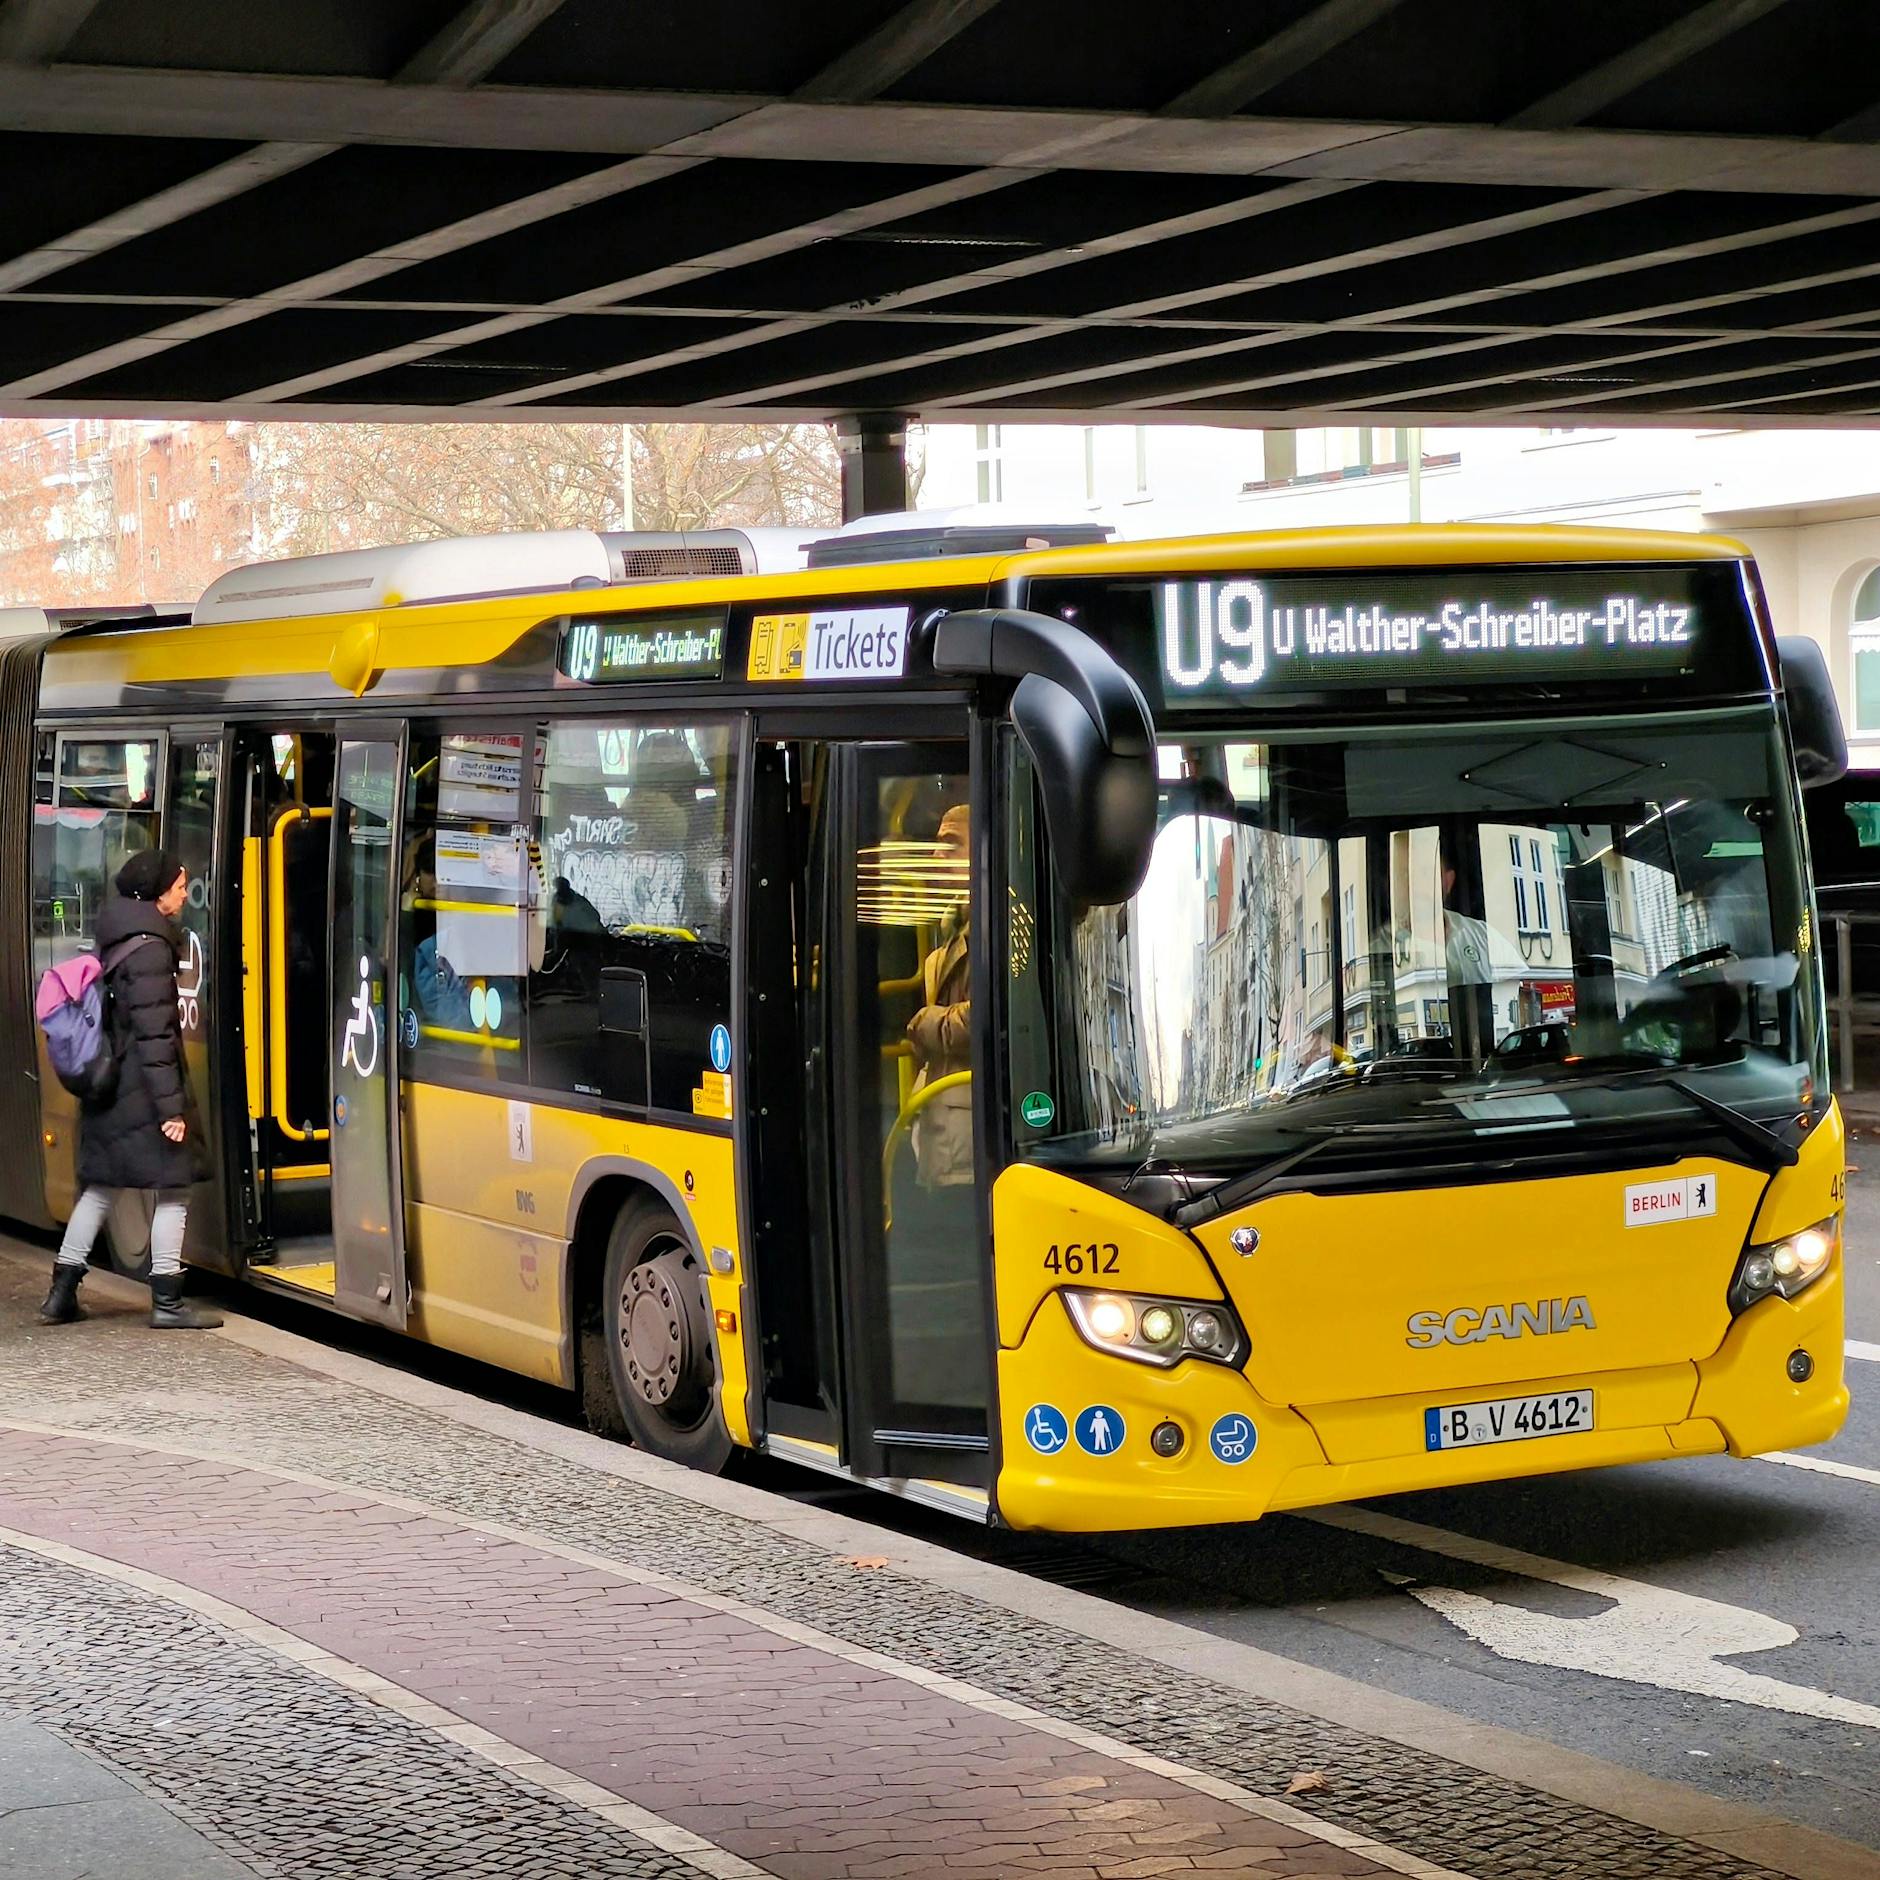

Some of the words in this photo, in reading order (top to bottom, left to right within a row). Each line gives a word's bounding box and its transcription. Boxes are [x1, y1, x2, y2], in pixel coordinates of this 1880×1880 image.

[570, 625, 598, 679] U9
[814, 618, 897, 670] Tickets
[1164, 581, 1265, 686] U9
[1273, 608, 1294, 655] U
[1305, 598, 1688, 654] Walther-Schreiber-Platz
[1632, 1192, 1682, 1213] BERLIN
[1043, 1243, 1120, 1275] 4612
[1406, 1295, 1597, 1349] SCANIA
[1451, 1410, 1469, 1442] B
[1489, 1405, 1505, 1437] V
[1514, 1396, 1580, 1433] 4612
